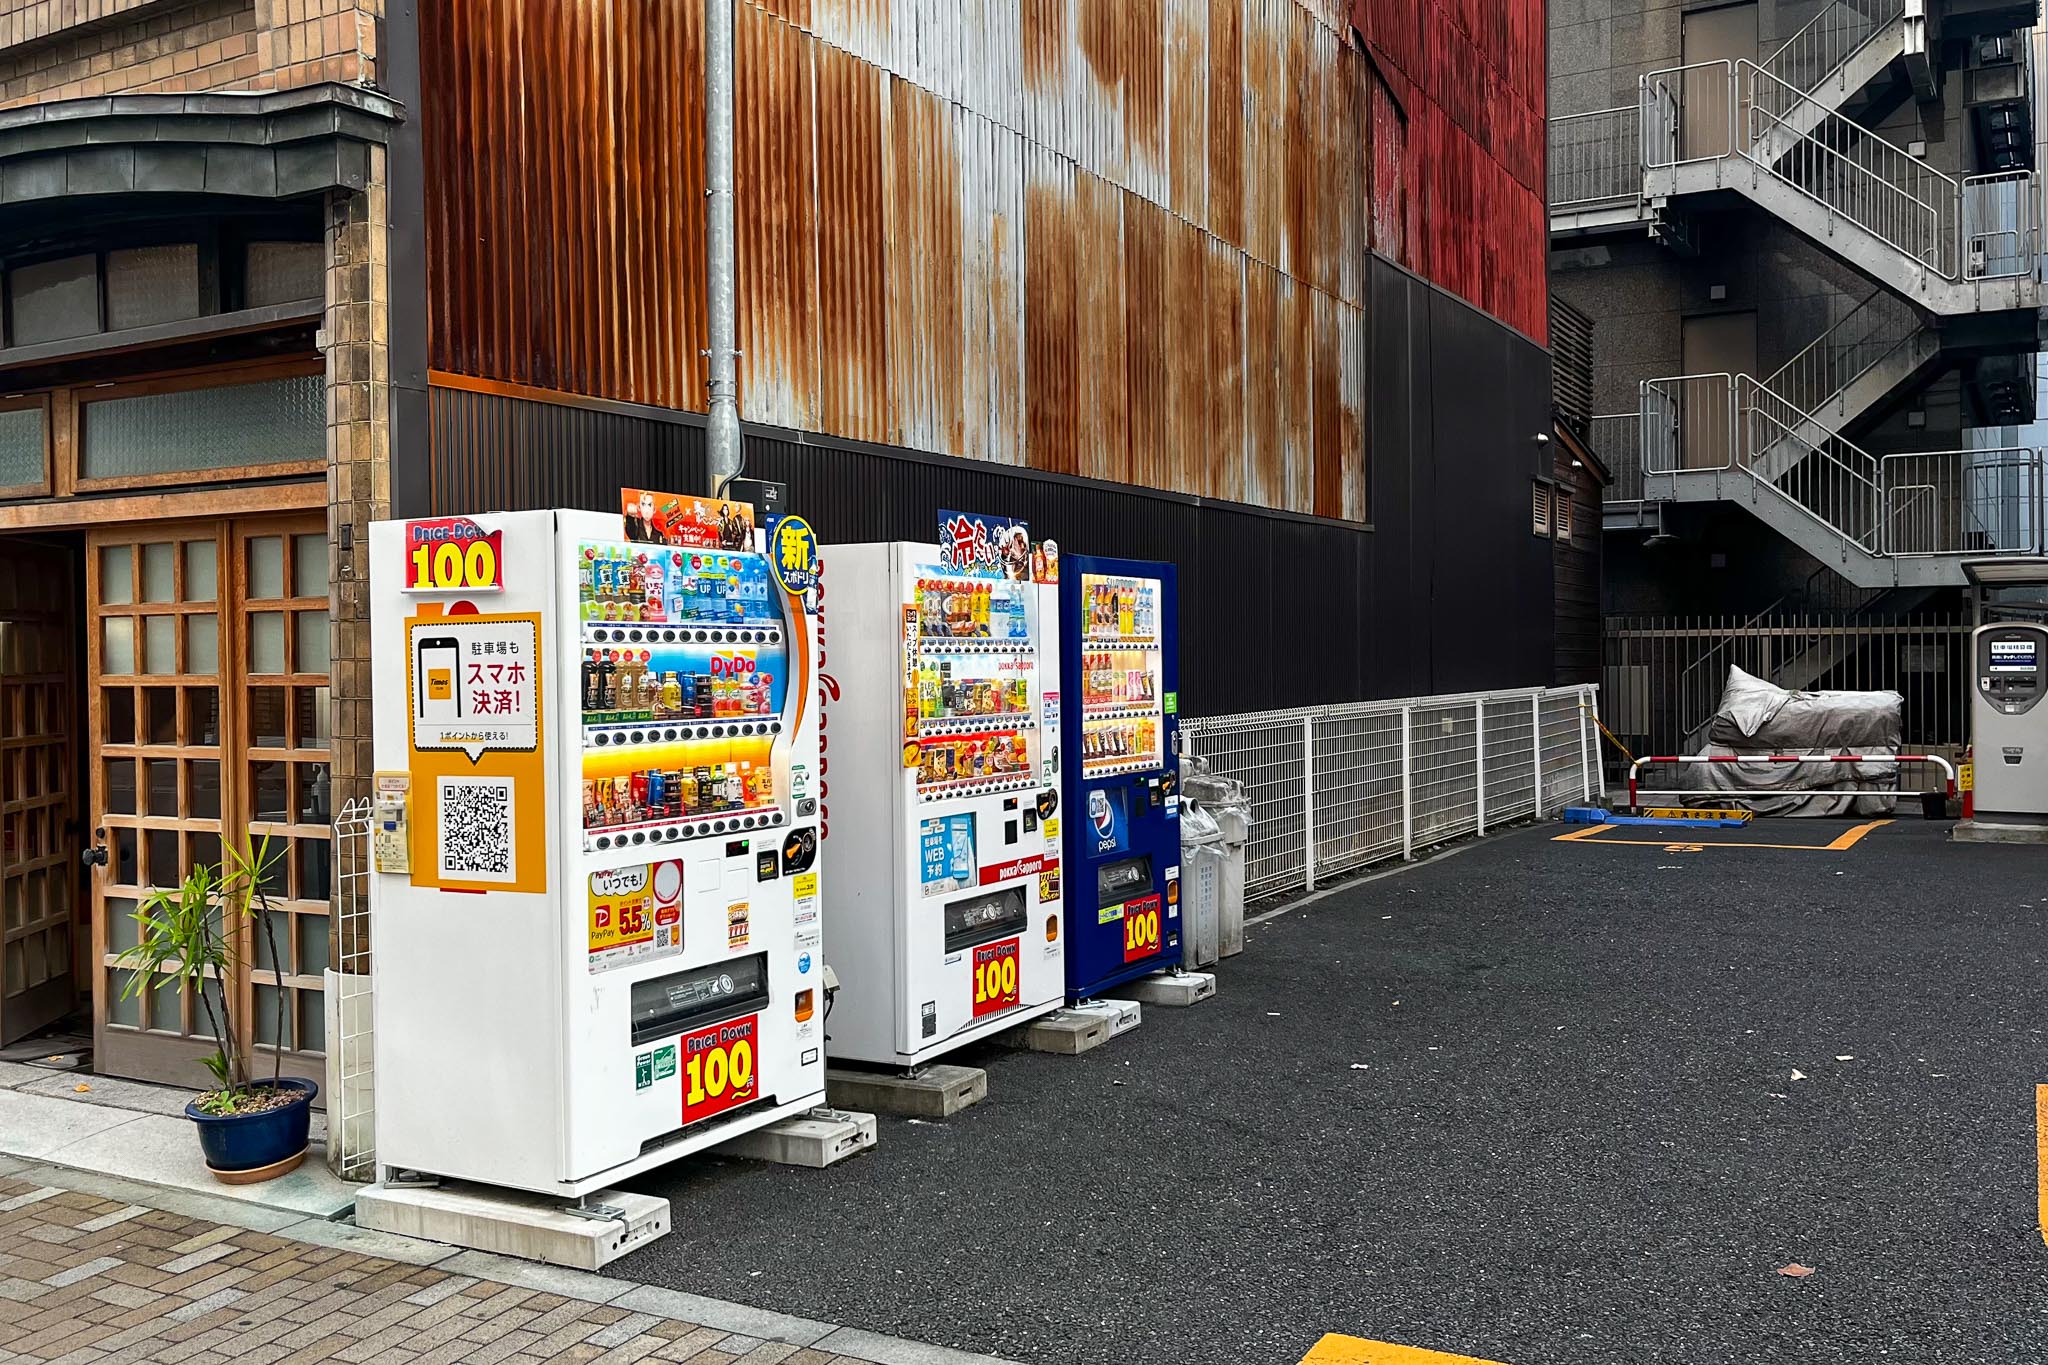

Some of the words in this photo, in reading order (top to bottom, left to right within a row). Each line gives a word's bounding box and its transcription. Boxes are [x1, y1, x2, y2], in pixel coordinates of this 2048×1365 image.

[780, 526, 809, 571] 新
[412, 541, 496, 588] 100
[782, 570, 809, 585] スポドリ
[471, 641, 520, 656] 駐車場も
[467, 661, 526, 685] スマホ
[711, 656, 756, 679] DyDo
[430, 678, 449, 686] Times
[472, 689, 521, 715] 決済!
[440, 731, 509, 741] 1ポイントから使える!
[925, 847, 945, 863] WEB
[1098, 836, 1118, 852] pepsi
[603, 873, 643, 891] いつでも!
[592, 929, 615, 940] PayPay
[1127, 911, 1158, 951] 100
[976, 956, 1016, 1004] 100
[688, 1032, 717, 1052] PRICE
[719, 1022, 753, 1042] DOWN
[687, 1039, 753, 1106] 100
